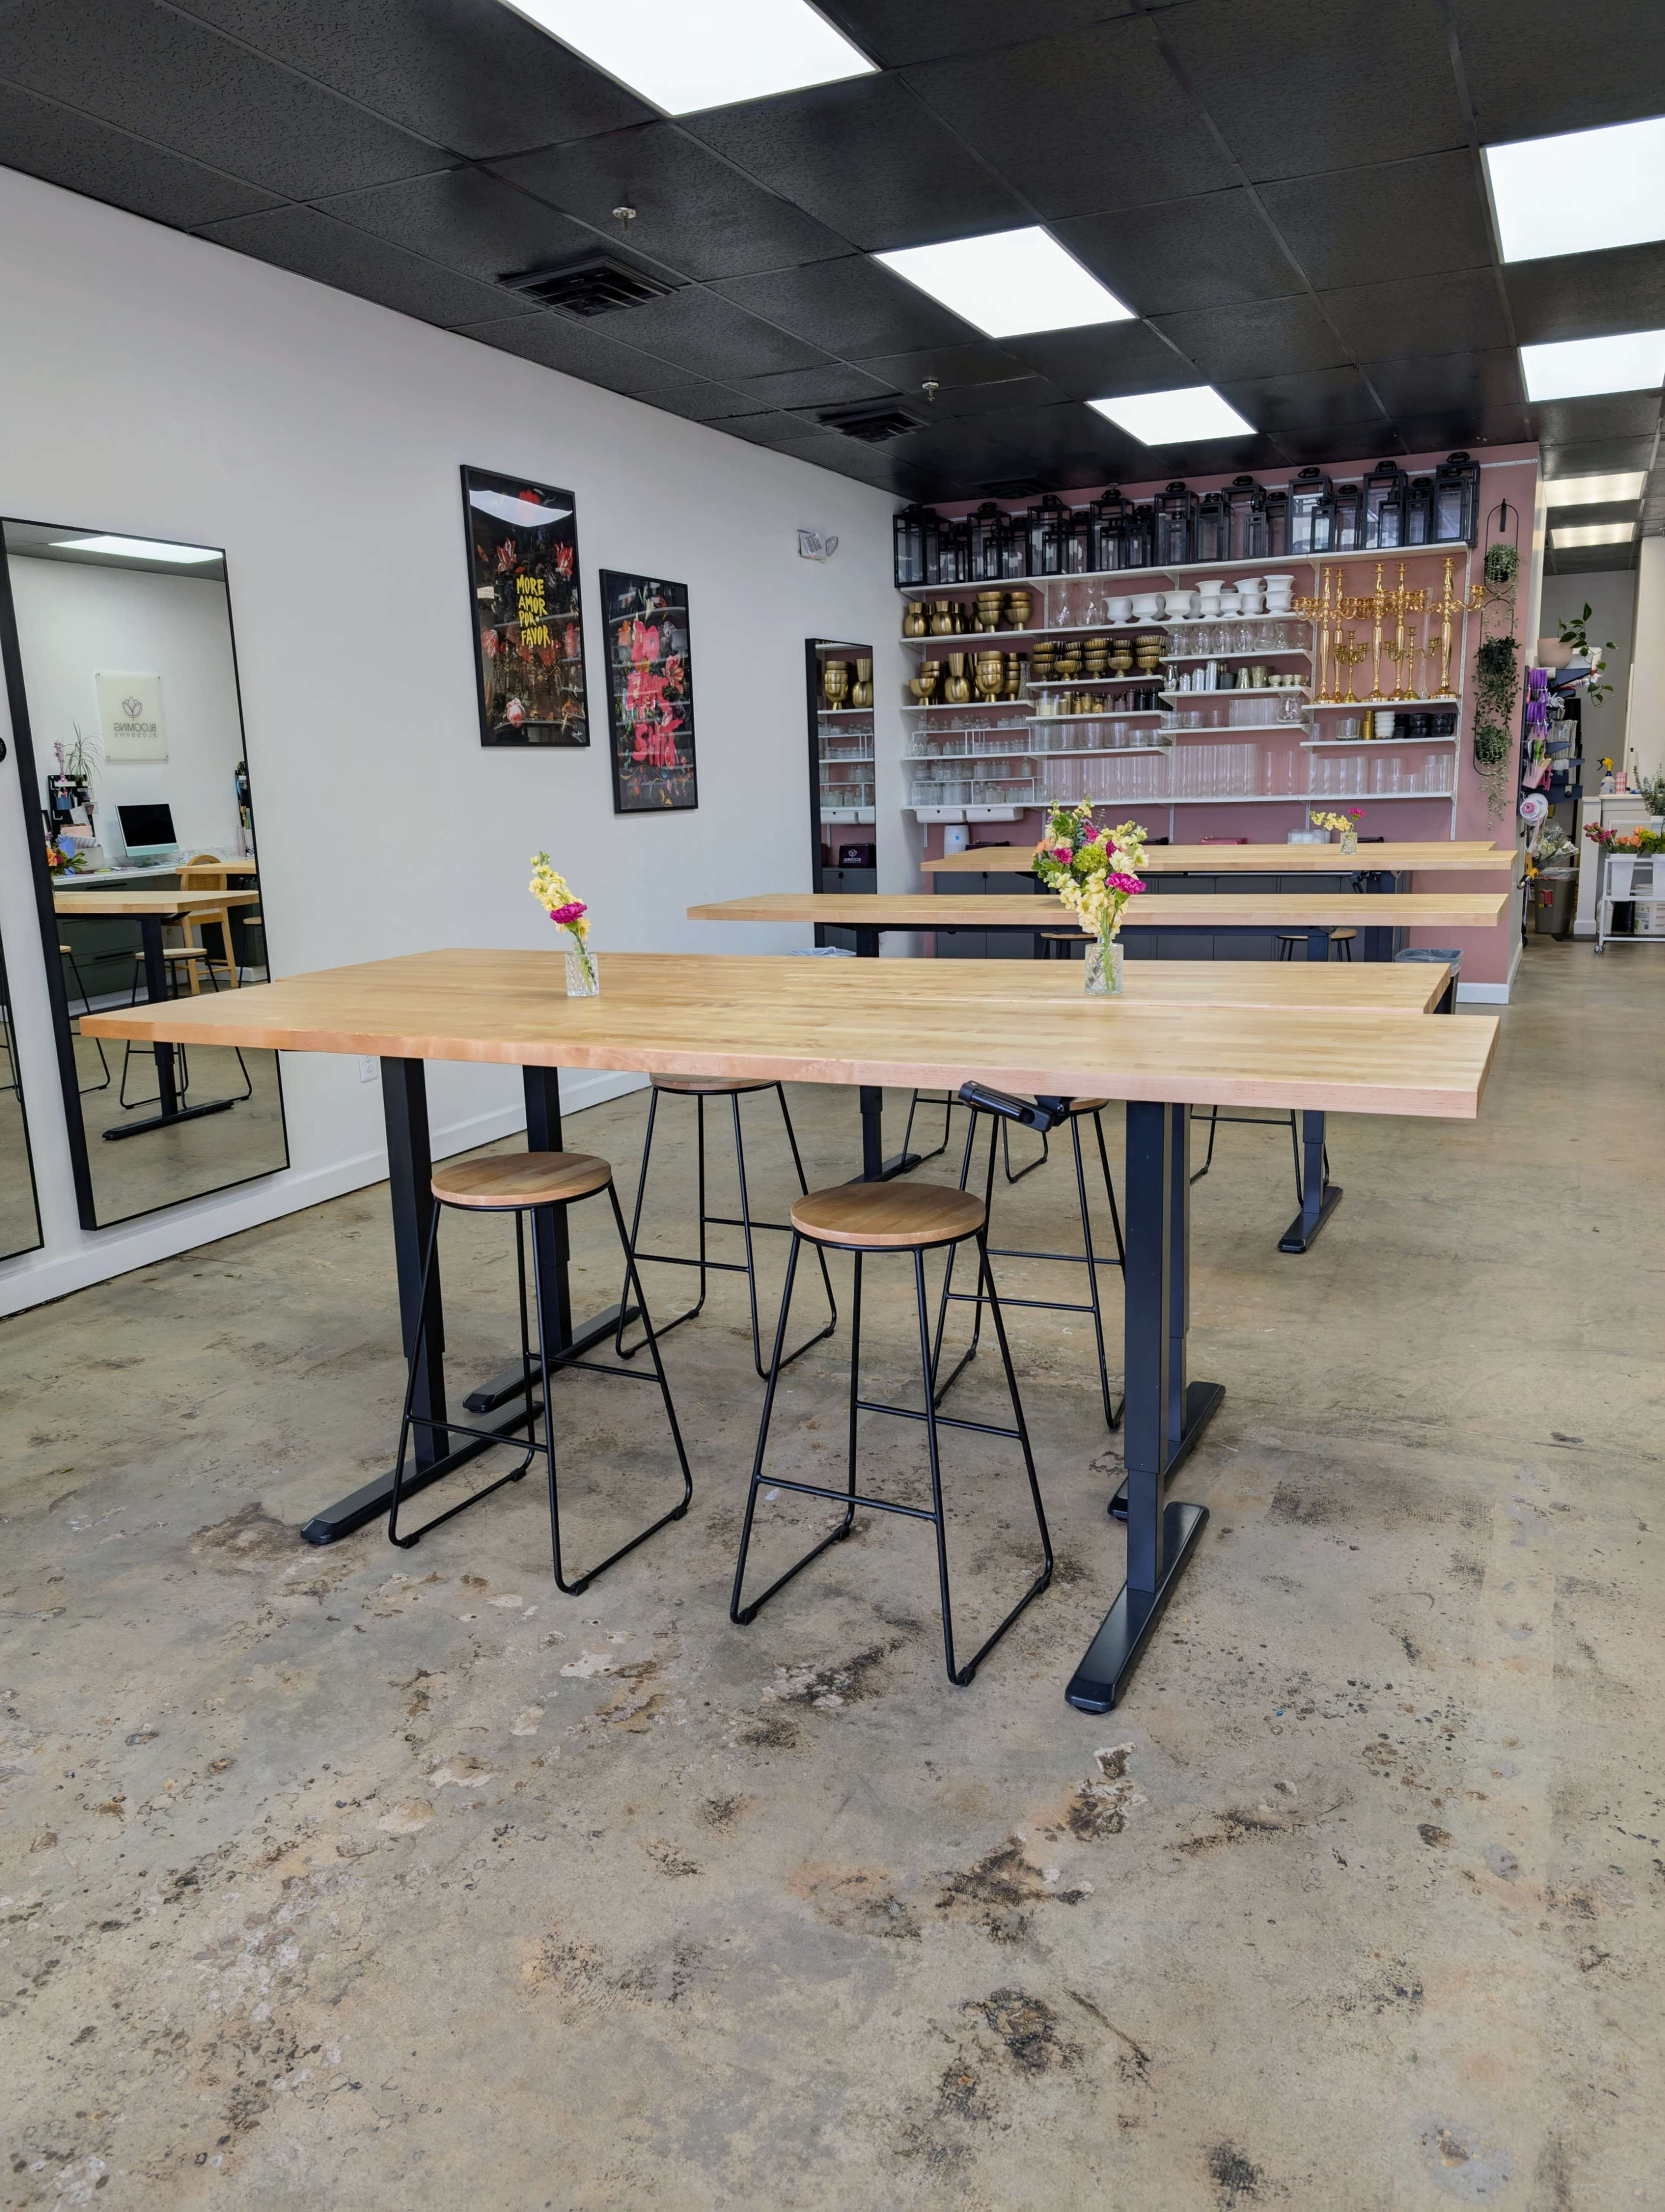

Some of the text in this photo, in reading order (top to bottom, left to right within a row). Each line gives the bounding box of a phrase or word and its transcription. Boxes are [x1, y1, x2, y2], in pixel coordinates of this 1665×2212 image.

[516, 574, 545, 596] MORE
[518, 595, 548, 617] AMOR
[519, 610, 538, 627] POR
[521, 624, 551, 648] FAVOR
[632, 719, 684, 769] SHIT
